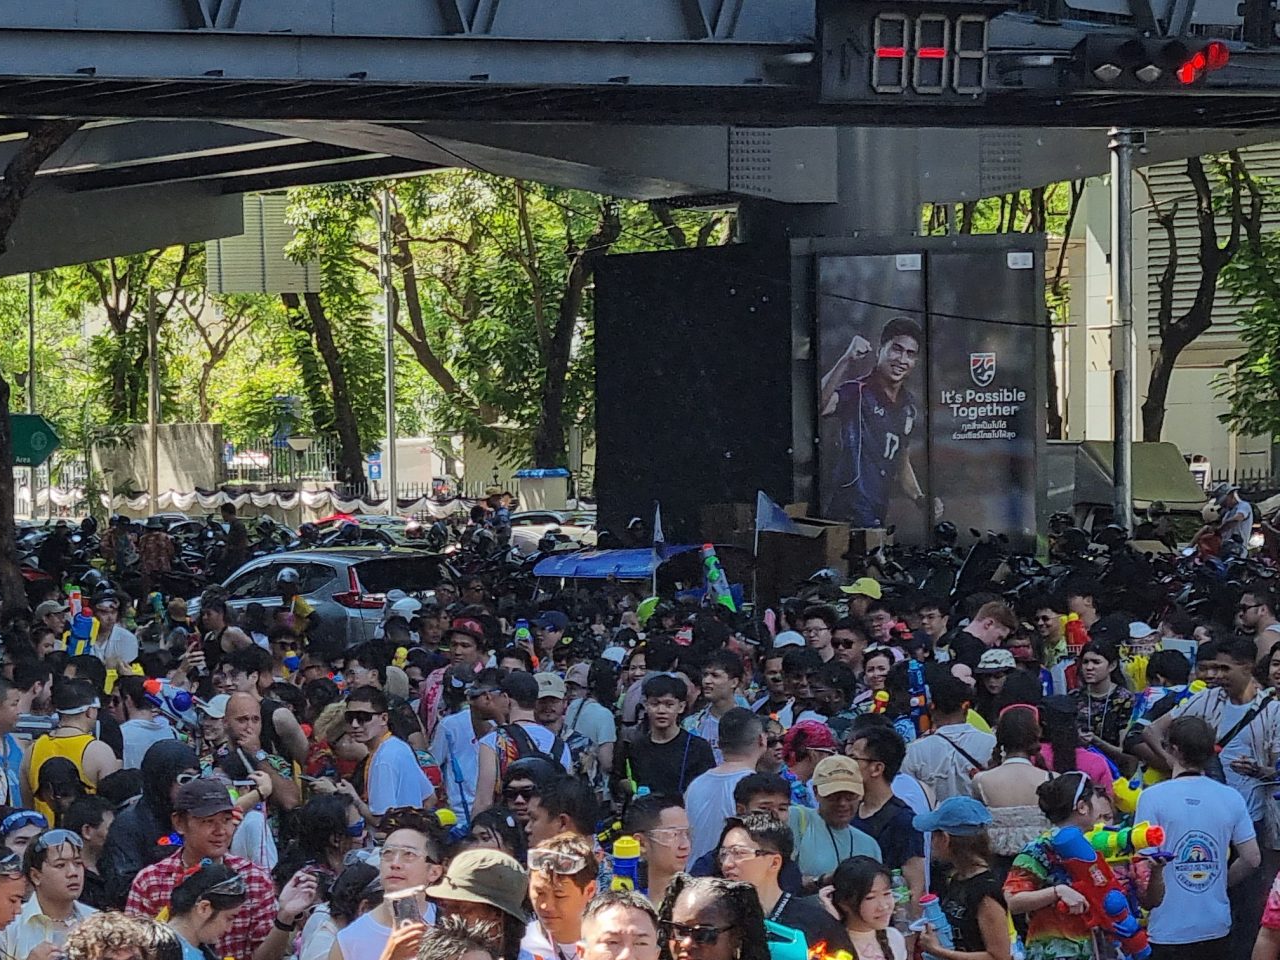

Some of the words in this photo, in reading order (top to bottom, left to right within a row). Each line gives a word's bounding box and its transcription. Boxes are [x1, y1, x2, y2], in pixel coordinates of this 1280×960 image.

[941, 390, 963, 404] It's
[966, 388, 1026, 403] Possible
[949, 403, 1018, 420] Together
[15, 456, 31, 464] Area
